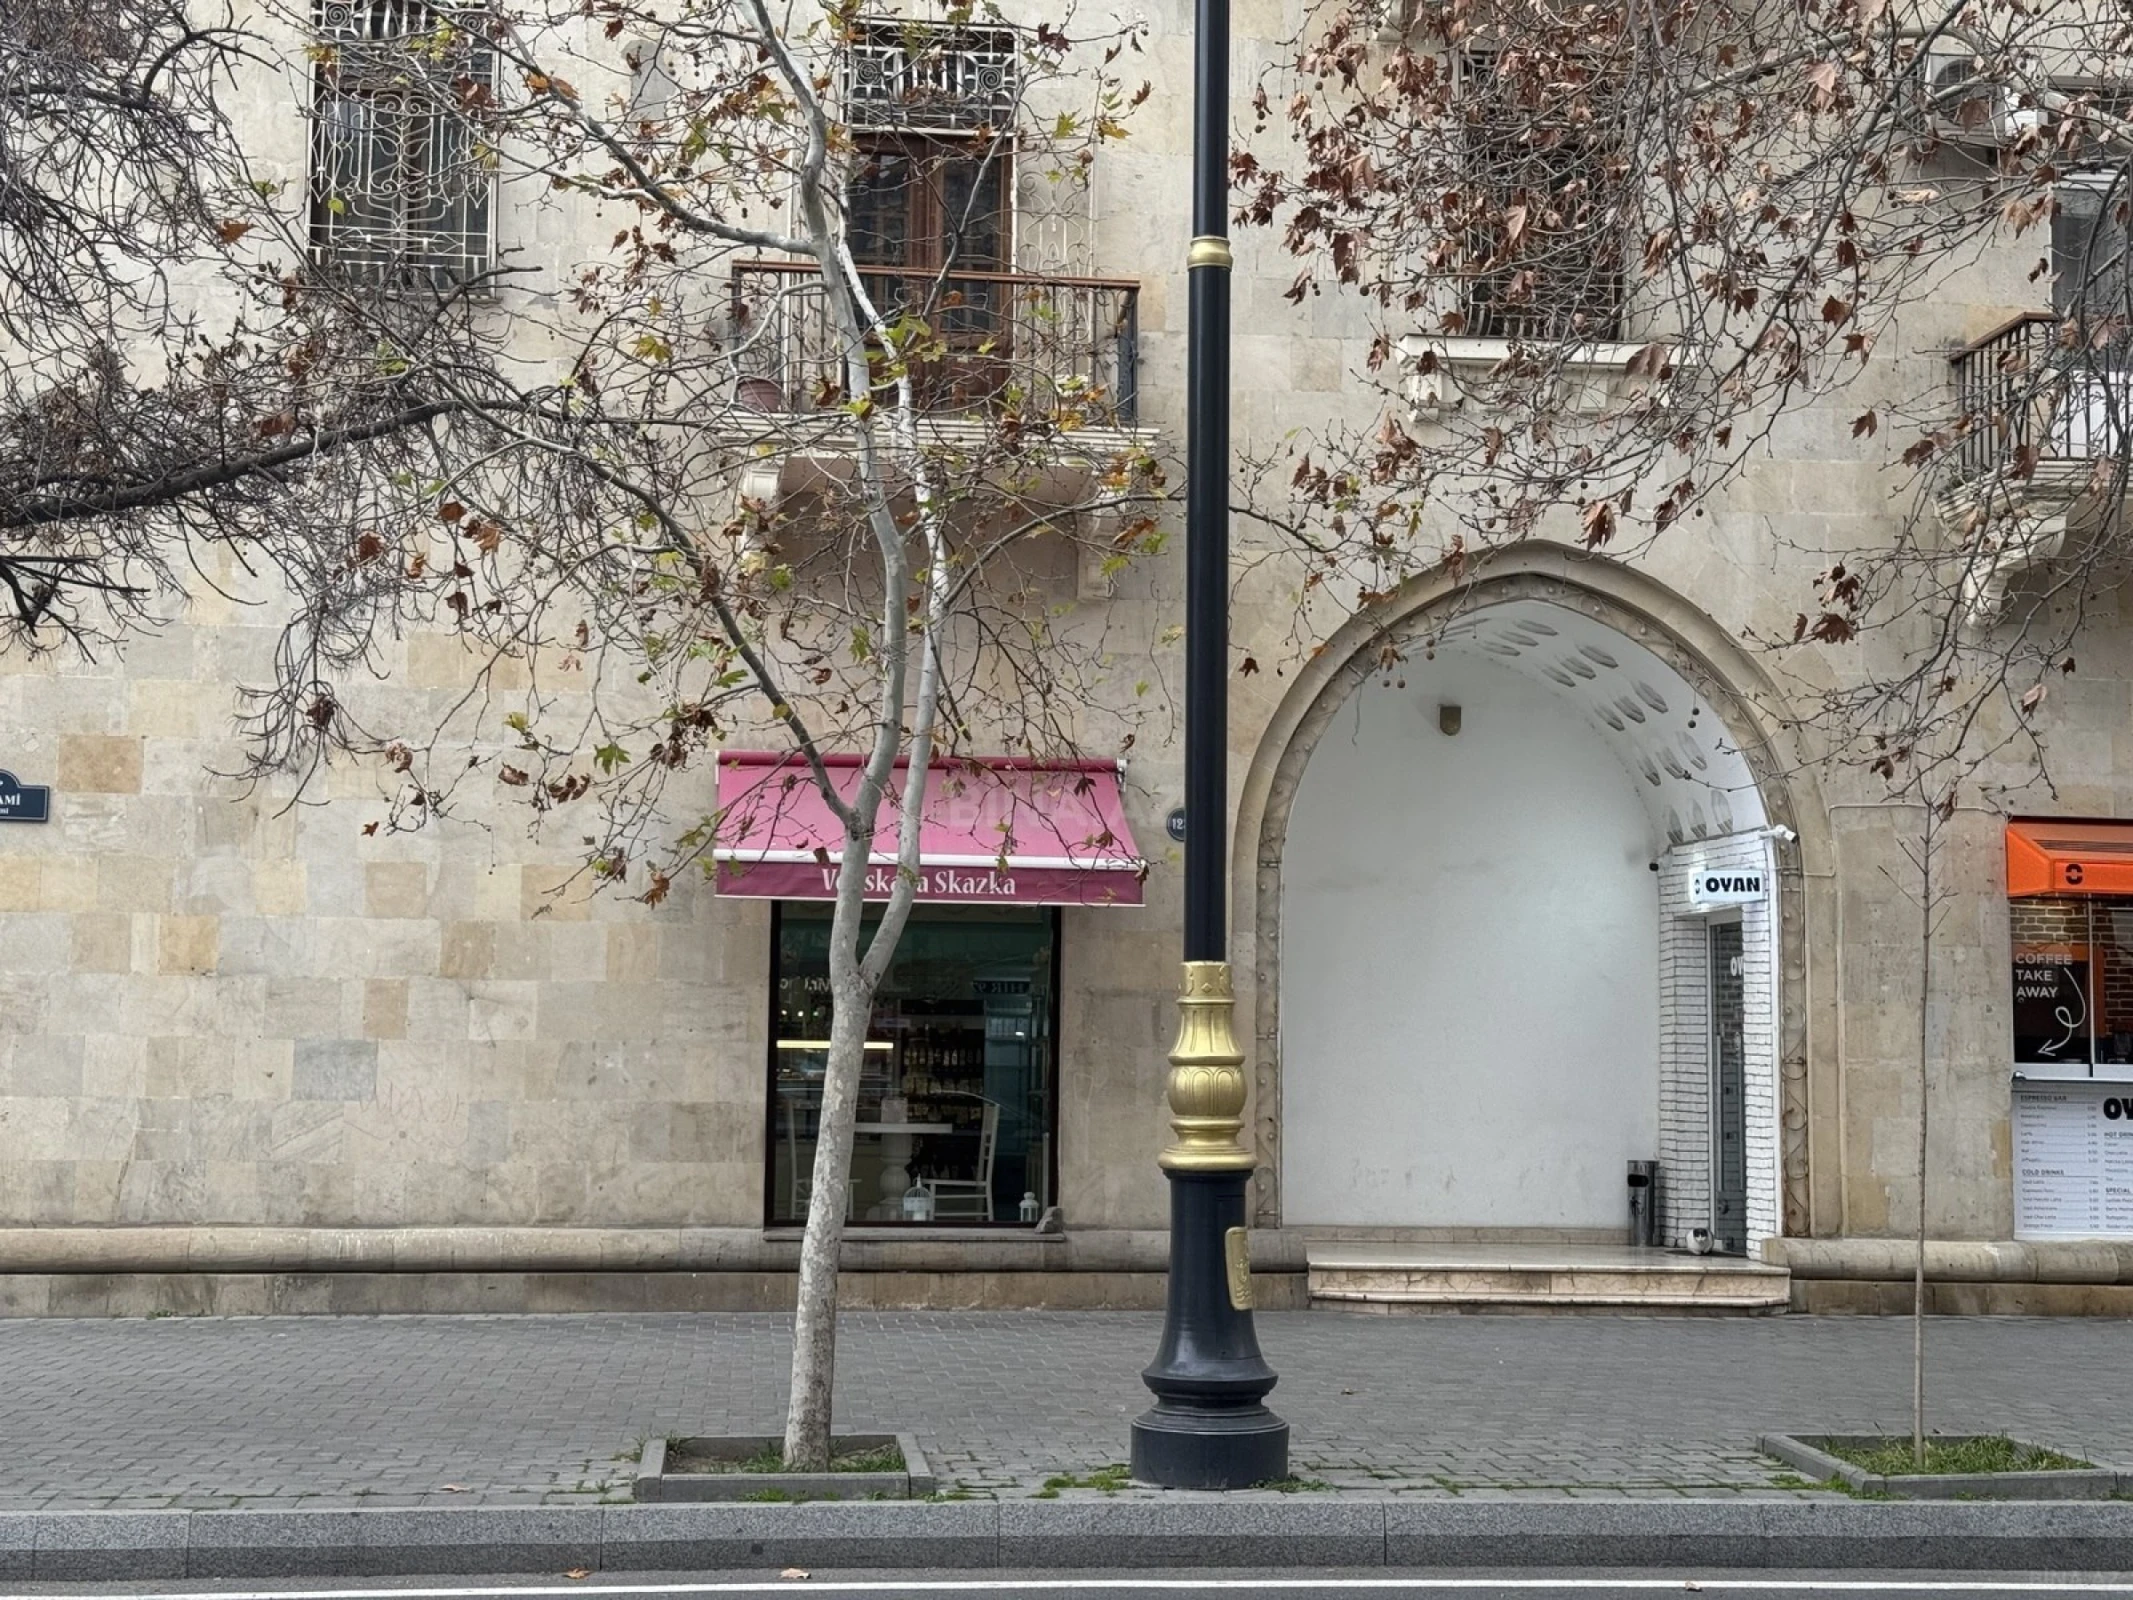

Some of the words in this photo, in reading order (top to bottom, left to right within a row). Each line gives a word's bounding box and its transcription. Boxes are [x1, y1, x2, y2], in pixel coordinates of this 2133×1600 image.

[935, 870, 1016, 896] Skazka
[1705, 876, 1760, 893] OYAN
[2015, 952, 2073, 965] COFFEE
[2015, 969, 2053, 982] TAKE
[2015, 986, 2059, 998] AWAY
[2021, 1168, 2040, 1176] COLD
